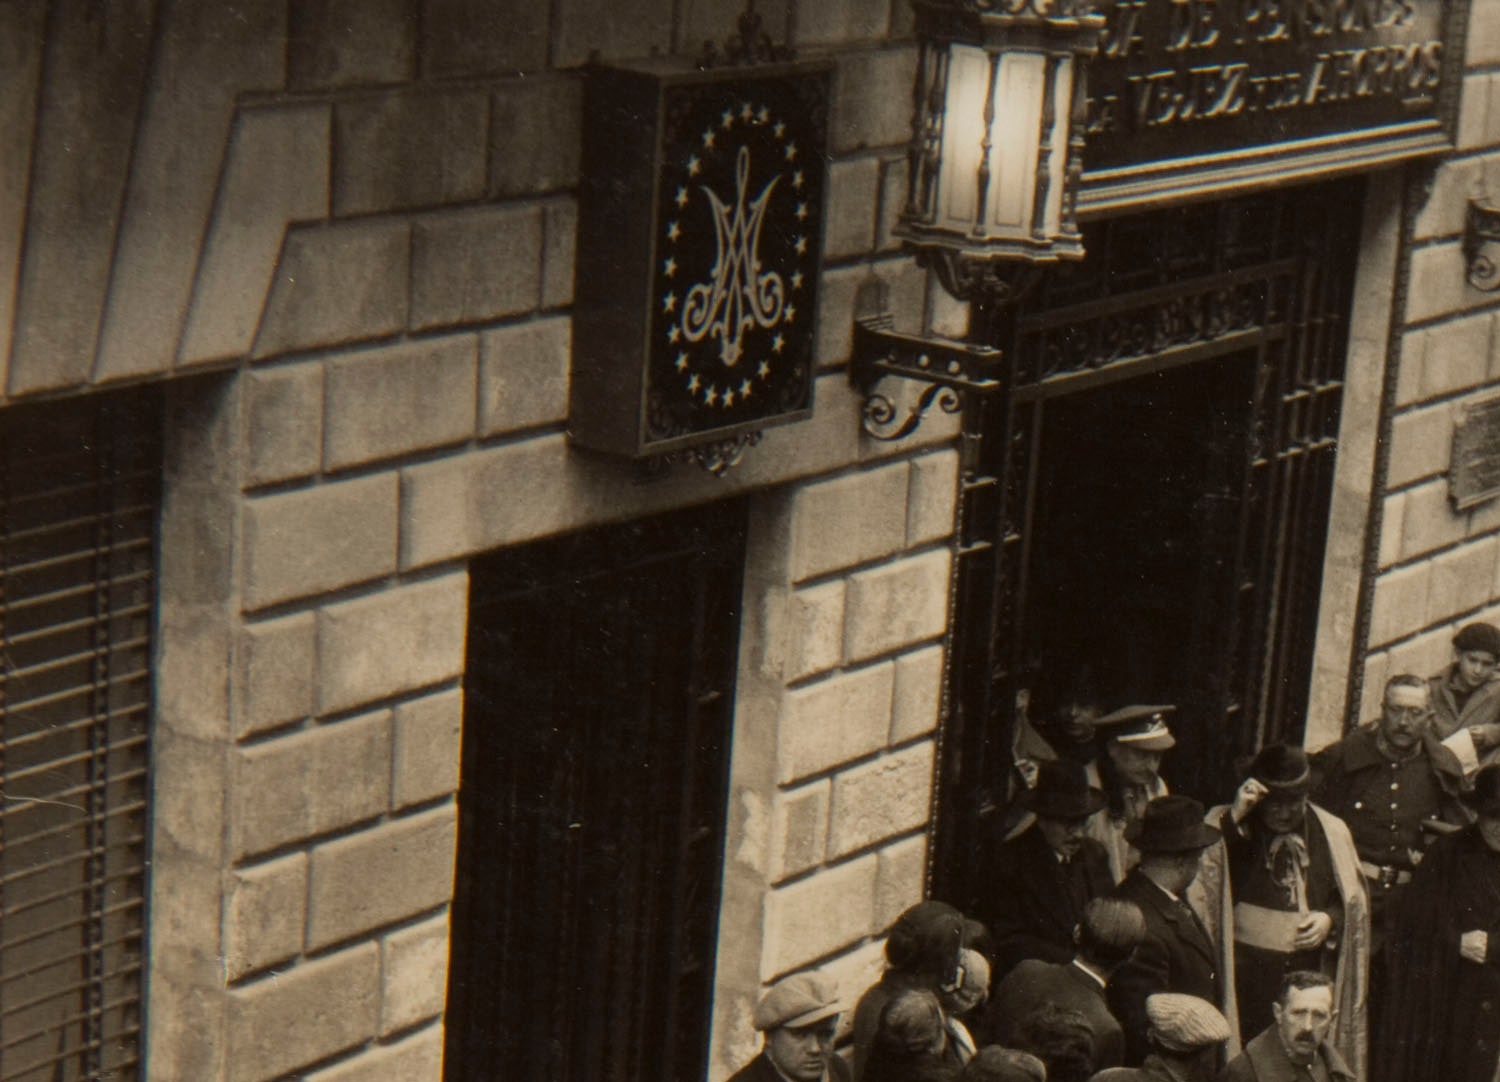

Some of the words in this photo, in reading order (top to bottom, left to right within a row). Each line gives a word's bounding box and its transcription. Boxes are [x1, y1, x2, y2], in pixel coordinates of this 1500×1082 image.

[1165, 0, 1220, 51] DE
[1127, 62, 1249, 126] VEJEZ
[1304, 41, 1443, 105] AHORROS
